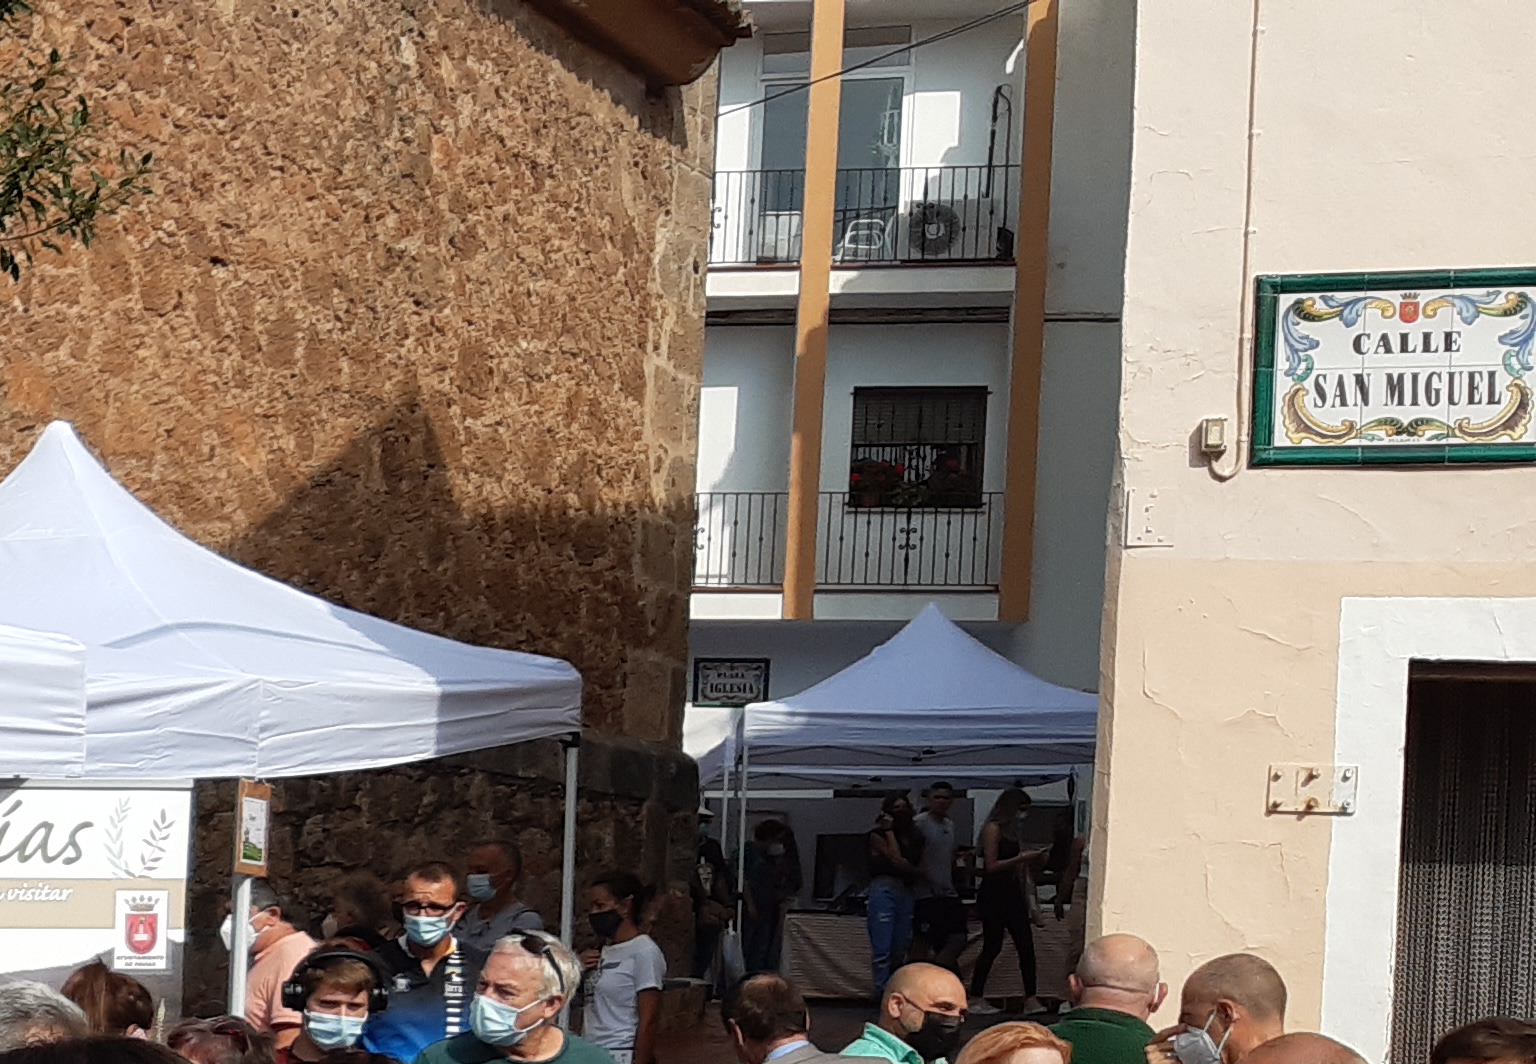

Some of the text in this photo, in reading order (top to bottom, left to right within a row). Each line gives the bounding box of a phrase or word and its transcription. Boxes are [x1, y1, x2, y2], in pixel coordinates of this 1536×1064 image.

[1352, 330, 1462, 356] CALLE
[1313, 370, 1503, 409] SAN MIGUEL
[709, 682, 754, 694] IGLESIA
[7, 882, 74, 901] visitar
